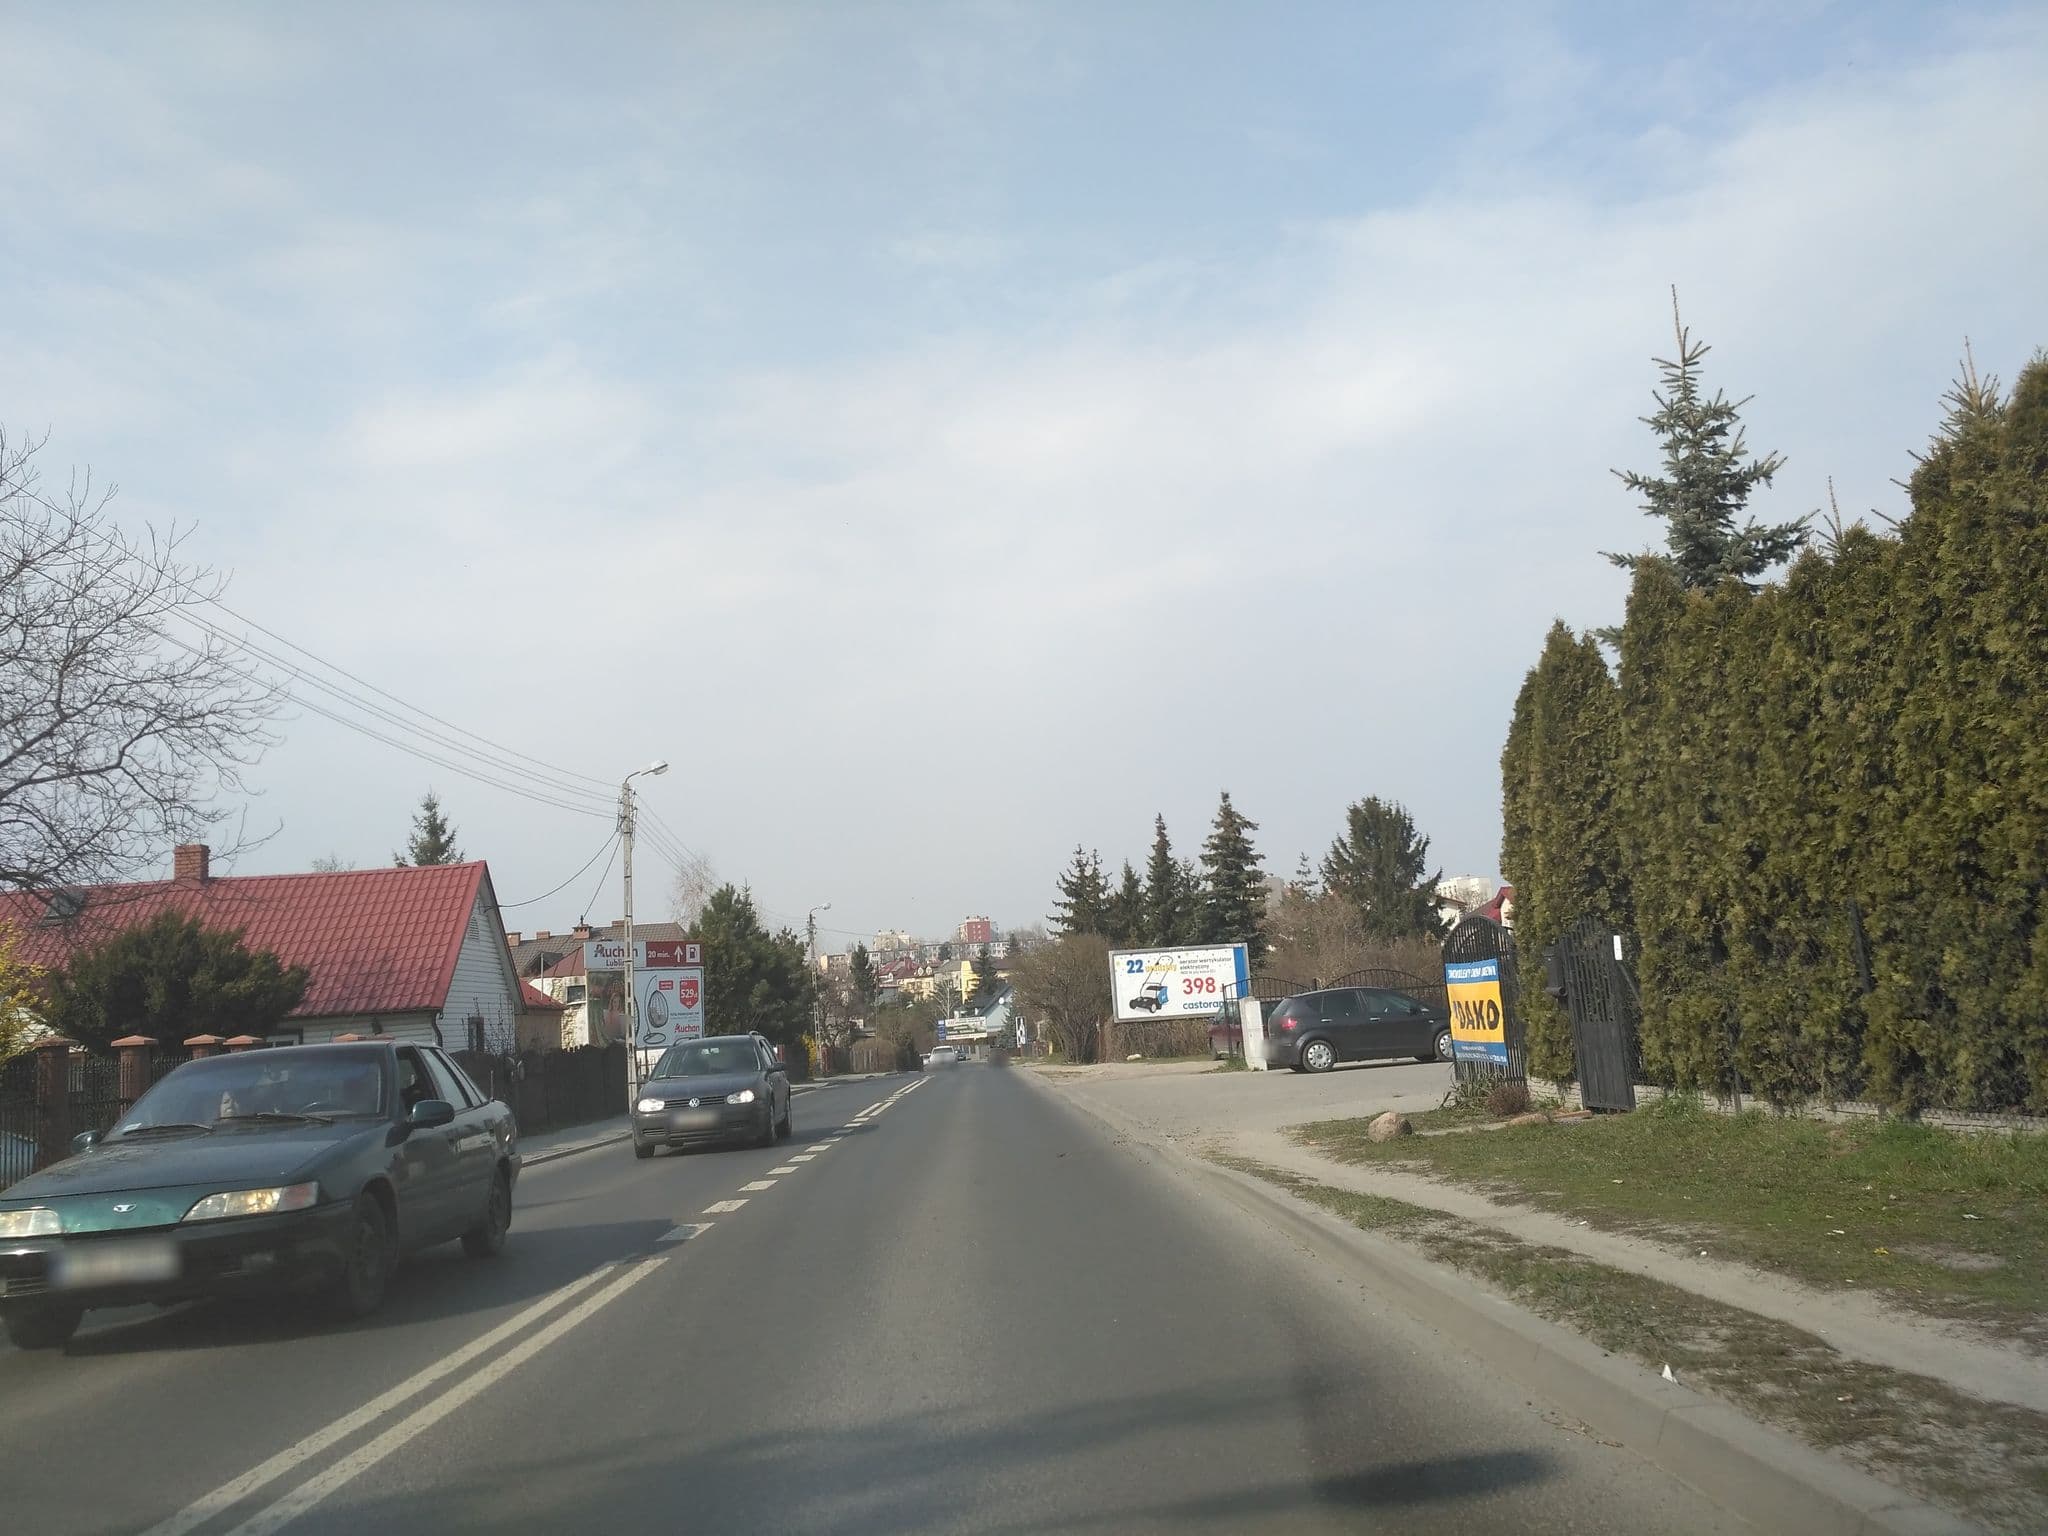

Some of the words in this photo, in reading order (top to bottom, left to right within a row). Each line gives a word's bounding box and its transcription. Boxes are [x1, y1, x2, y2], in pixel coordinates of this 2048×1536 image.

[594, 945, 638, 957] Auchn
[648, 950, 656, 958] 20
[606, 959, 625, 967] Lubli
[1126, 959, 1144, 973] 22
[1182, 977, 1216, 995] 398
[1183, 1000, 1224, 1010] castora
[1454, 999, 1500, 1030] DAKO
[674, 1024, 700, 1033] Auchan
